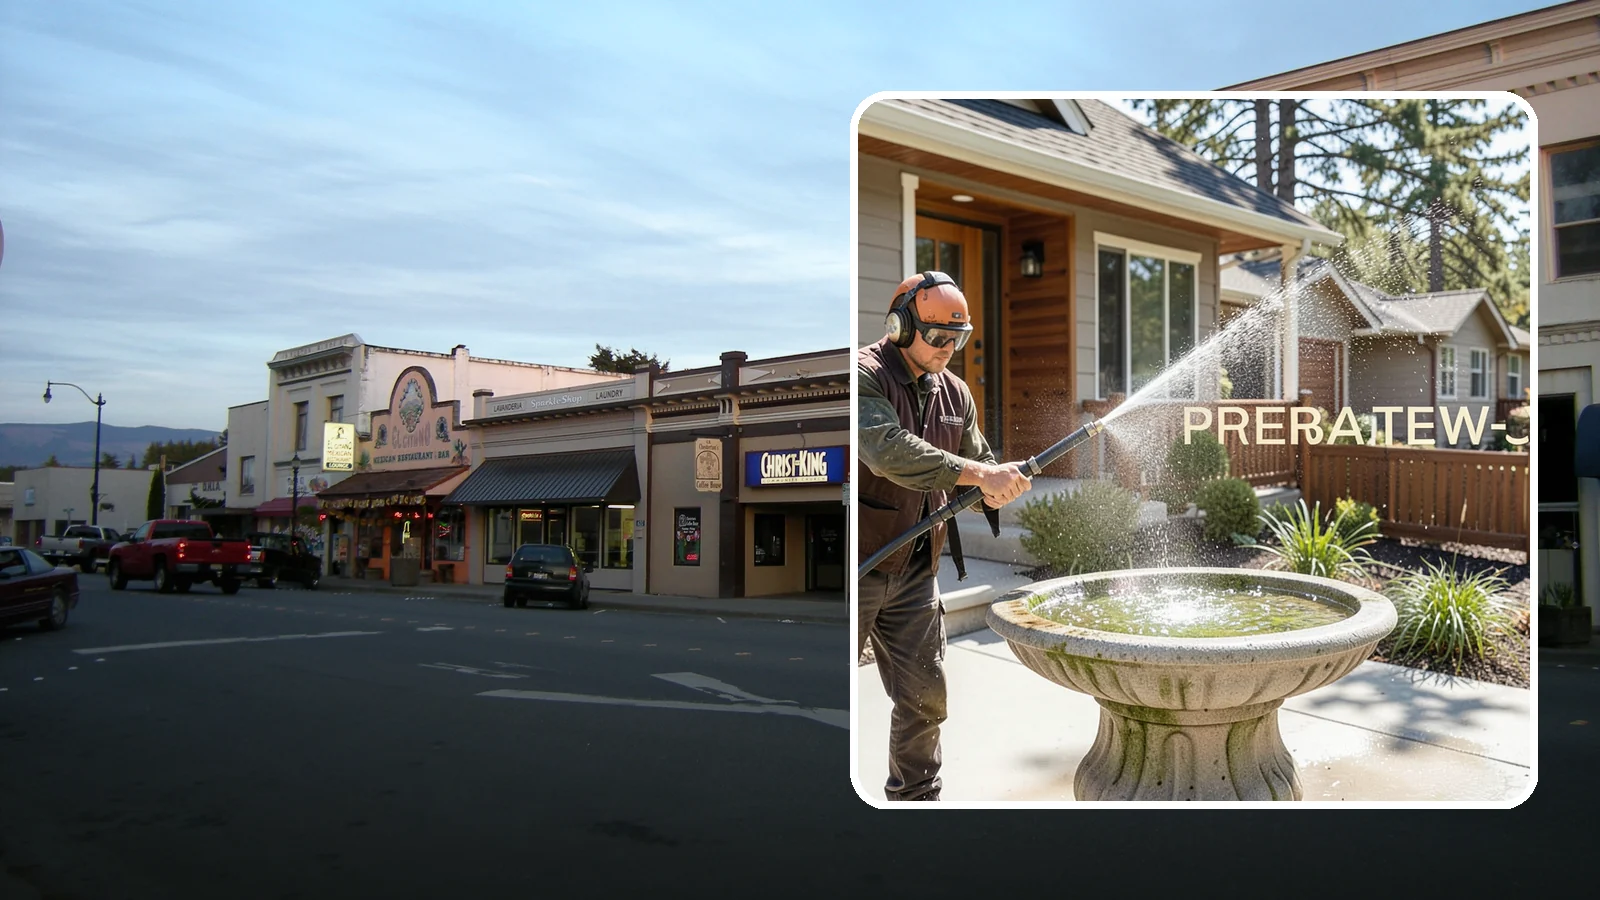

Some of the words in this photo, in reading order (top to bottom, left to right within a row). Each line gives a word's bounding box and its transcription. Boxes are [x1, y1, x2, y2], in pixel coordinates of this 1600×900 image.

[595, 389, 624, 400] LAUNDRY
[493, 402, 523, 413] LAVANDERIA
[373, 455, 396, 464] MEXICAN
[397, 451, 434, 462] RESTAURANT
[437, 450, 450, 459] BAR
[761, 452, 797, 478] CHRIST
[799, 450, 827, 476] KING
